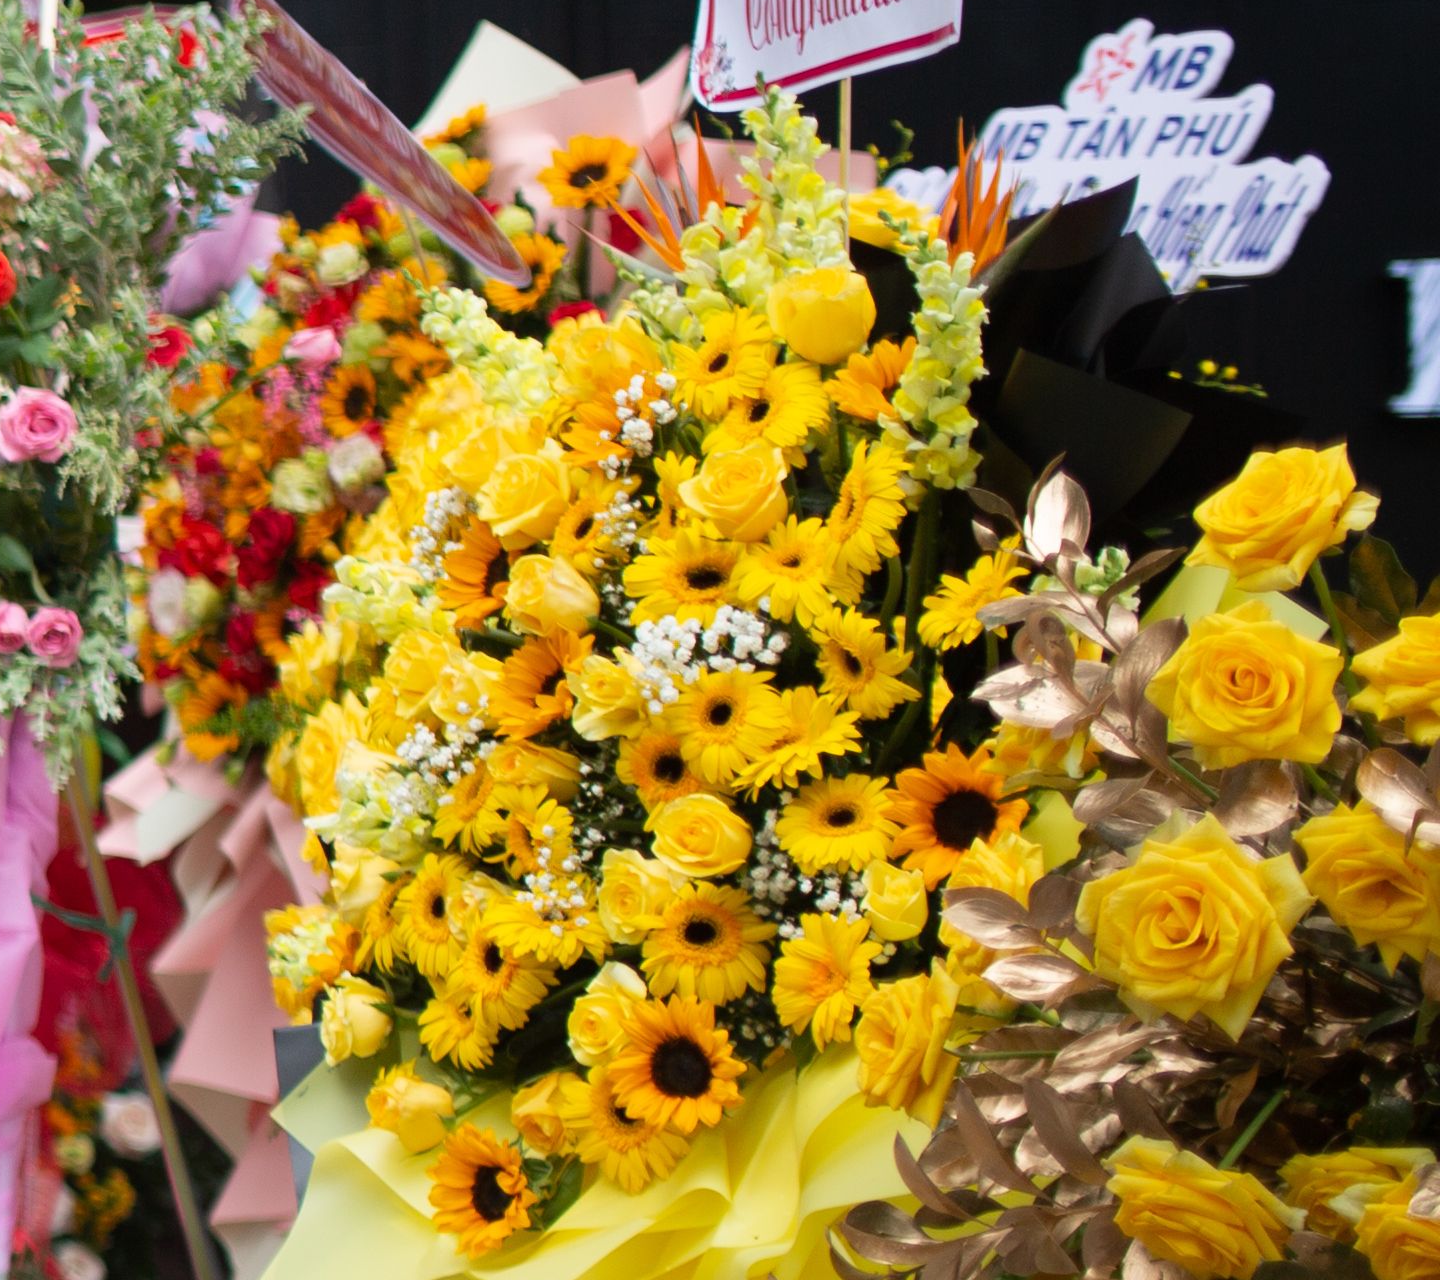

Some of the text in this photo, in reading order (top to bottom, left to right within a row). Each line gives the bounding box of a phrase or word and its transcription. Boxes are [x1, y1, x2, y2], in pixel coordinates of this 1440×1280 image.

[1131, 45, 1215, 93] MB
[984, 101, 1253, 161] MB TÂN PHÚ
